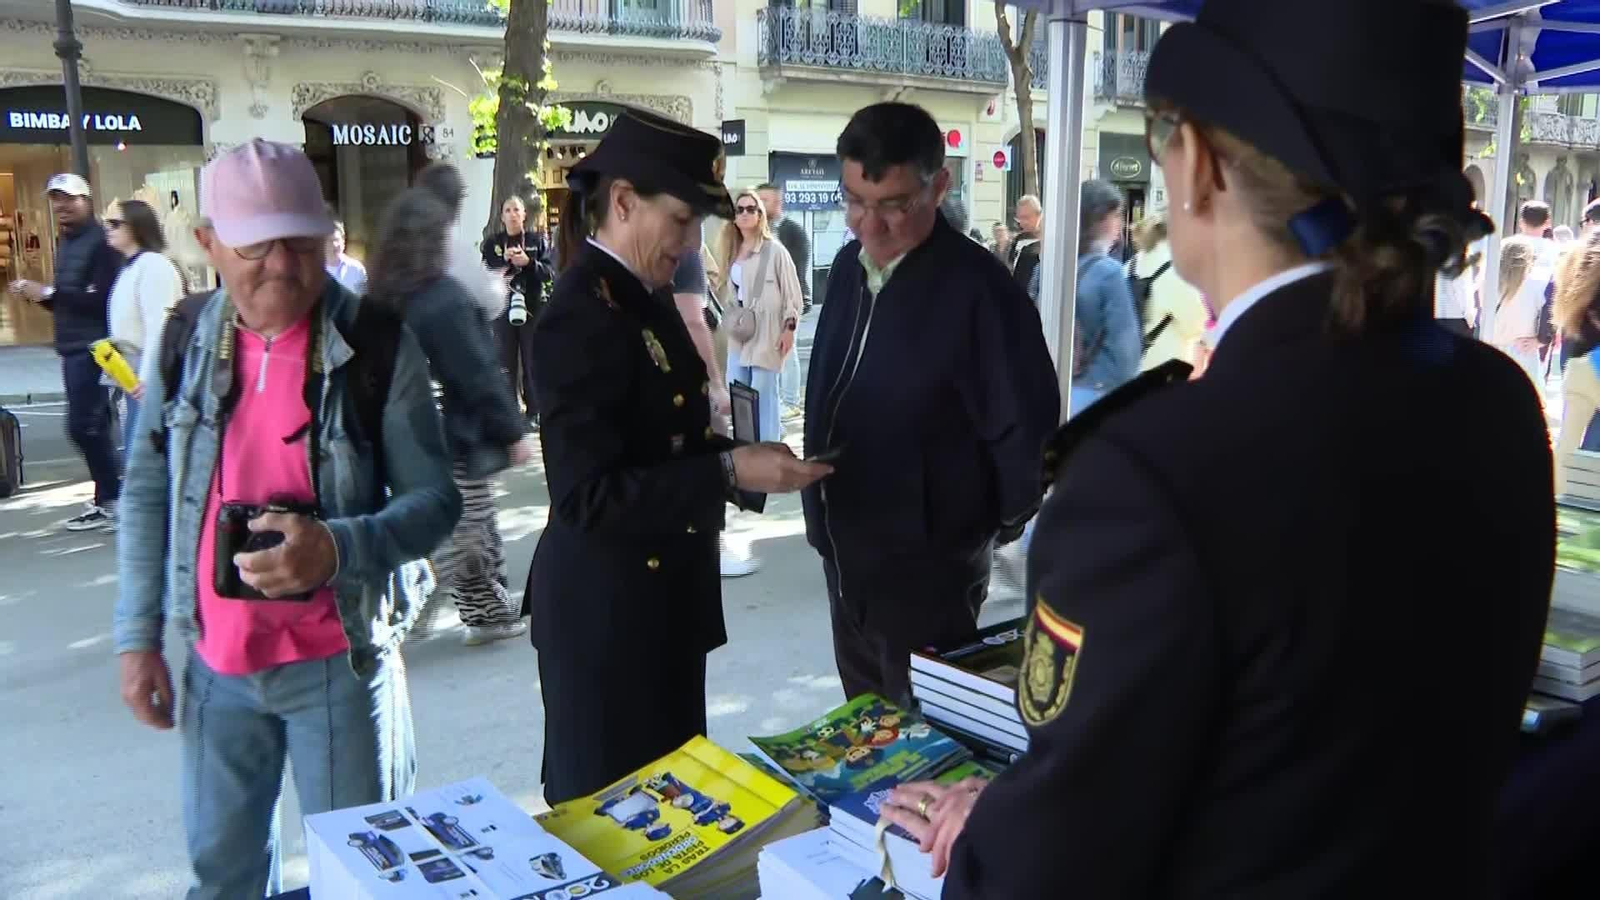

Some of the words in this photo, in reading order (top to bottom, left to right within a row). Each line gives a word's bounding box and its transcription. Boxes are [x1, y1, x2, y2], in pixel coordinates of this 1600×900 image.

[9, 112, 70, 129] BIMBA
[95, 114, 142, 130] LOLA
[332, 124, 412, 145] MOSAIC
[442, 127, 454, 138] 84
[785, 193, 797, 203] 93
[799, 193, 816, 203] 293
[818, 193, 829, 203] 19
[681, 845, 711, 865] TRAS
